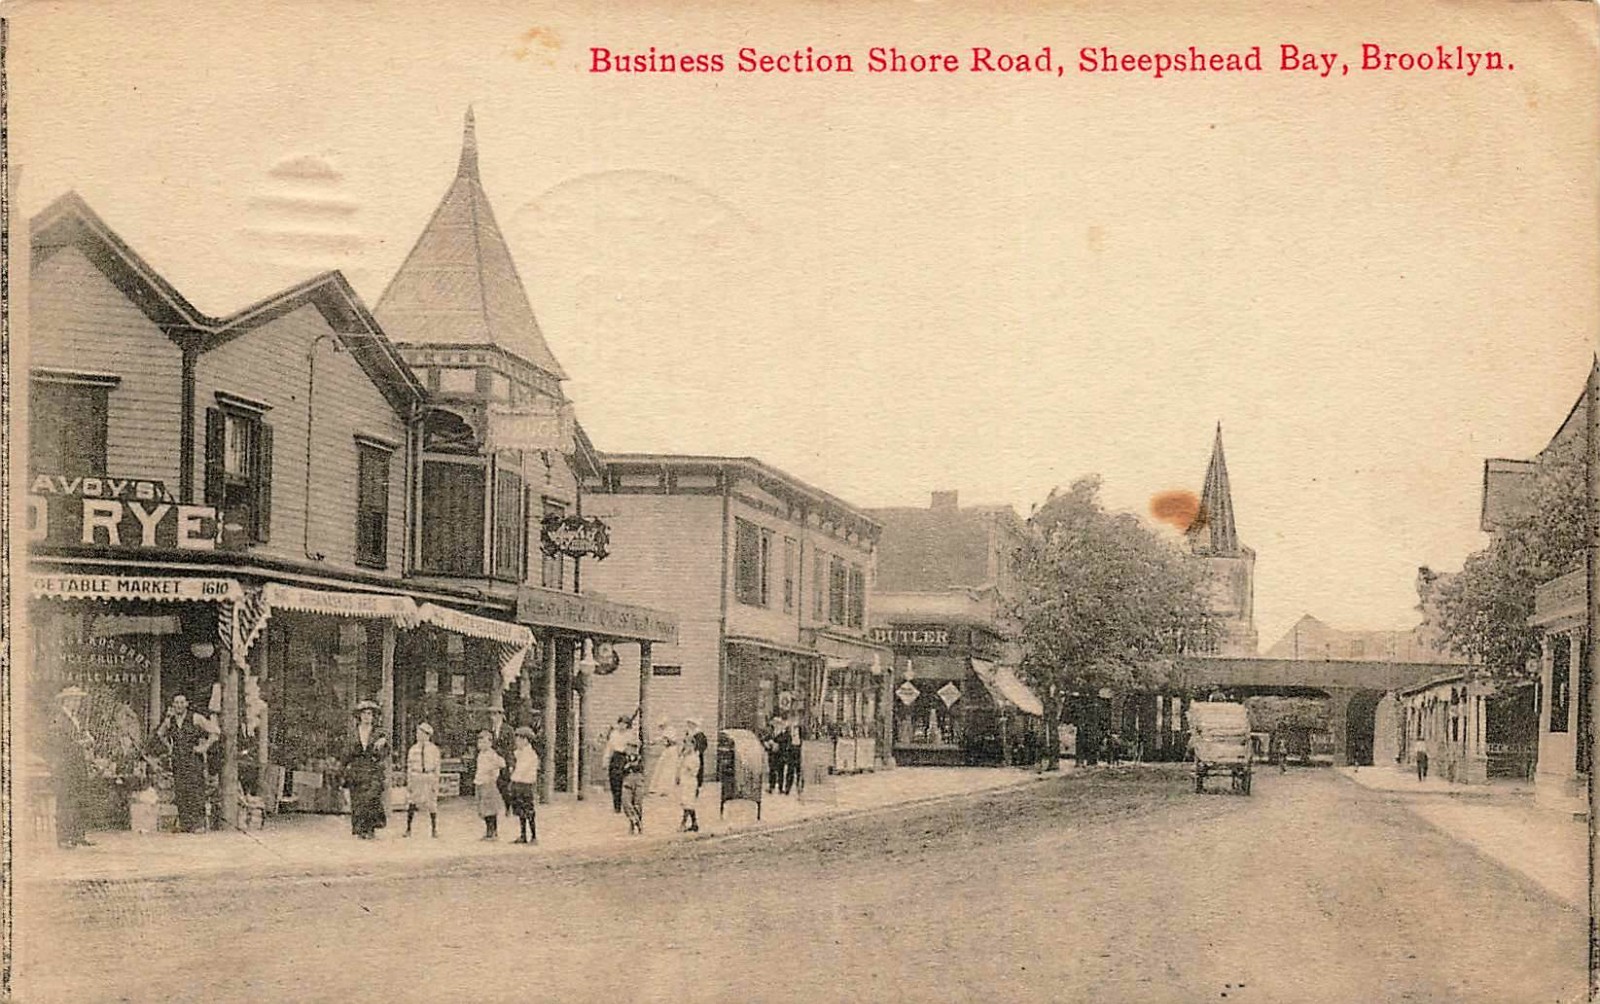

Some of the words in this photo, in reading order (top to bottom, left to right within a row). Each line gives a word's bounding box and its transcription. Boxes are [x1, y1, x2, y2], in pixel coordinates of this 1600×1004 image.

[82, 498, 217, 551] RYE
[117, 580, 181, 594] MARKET
[202, 582, 229, 595] 1610
[874, 629, 949, 644] BUTLER
